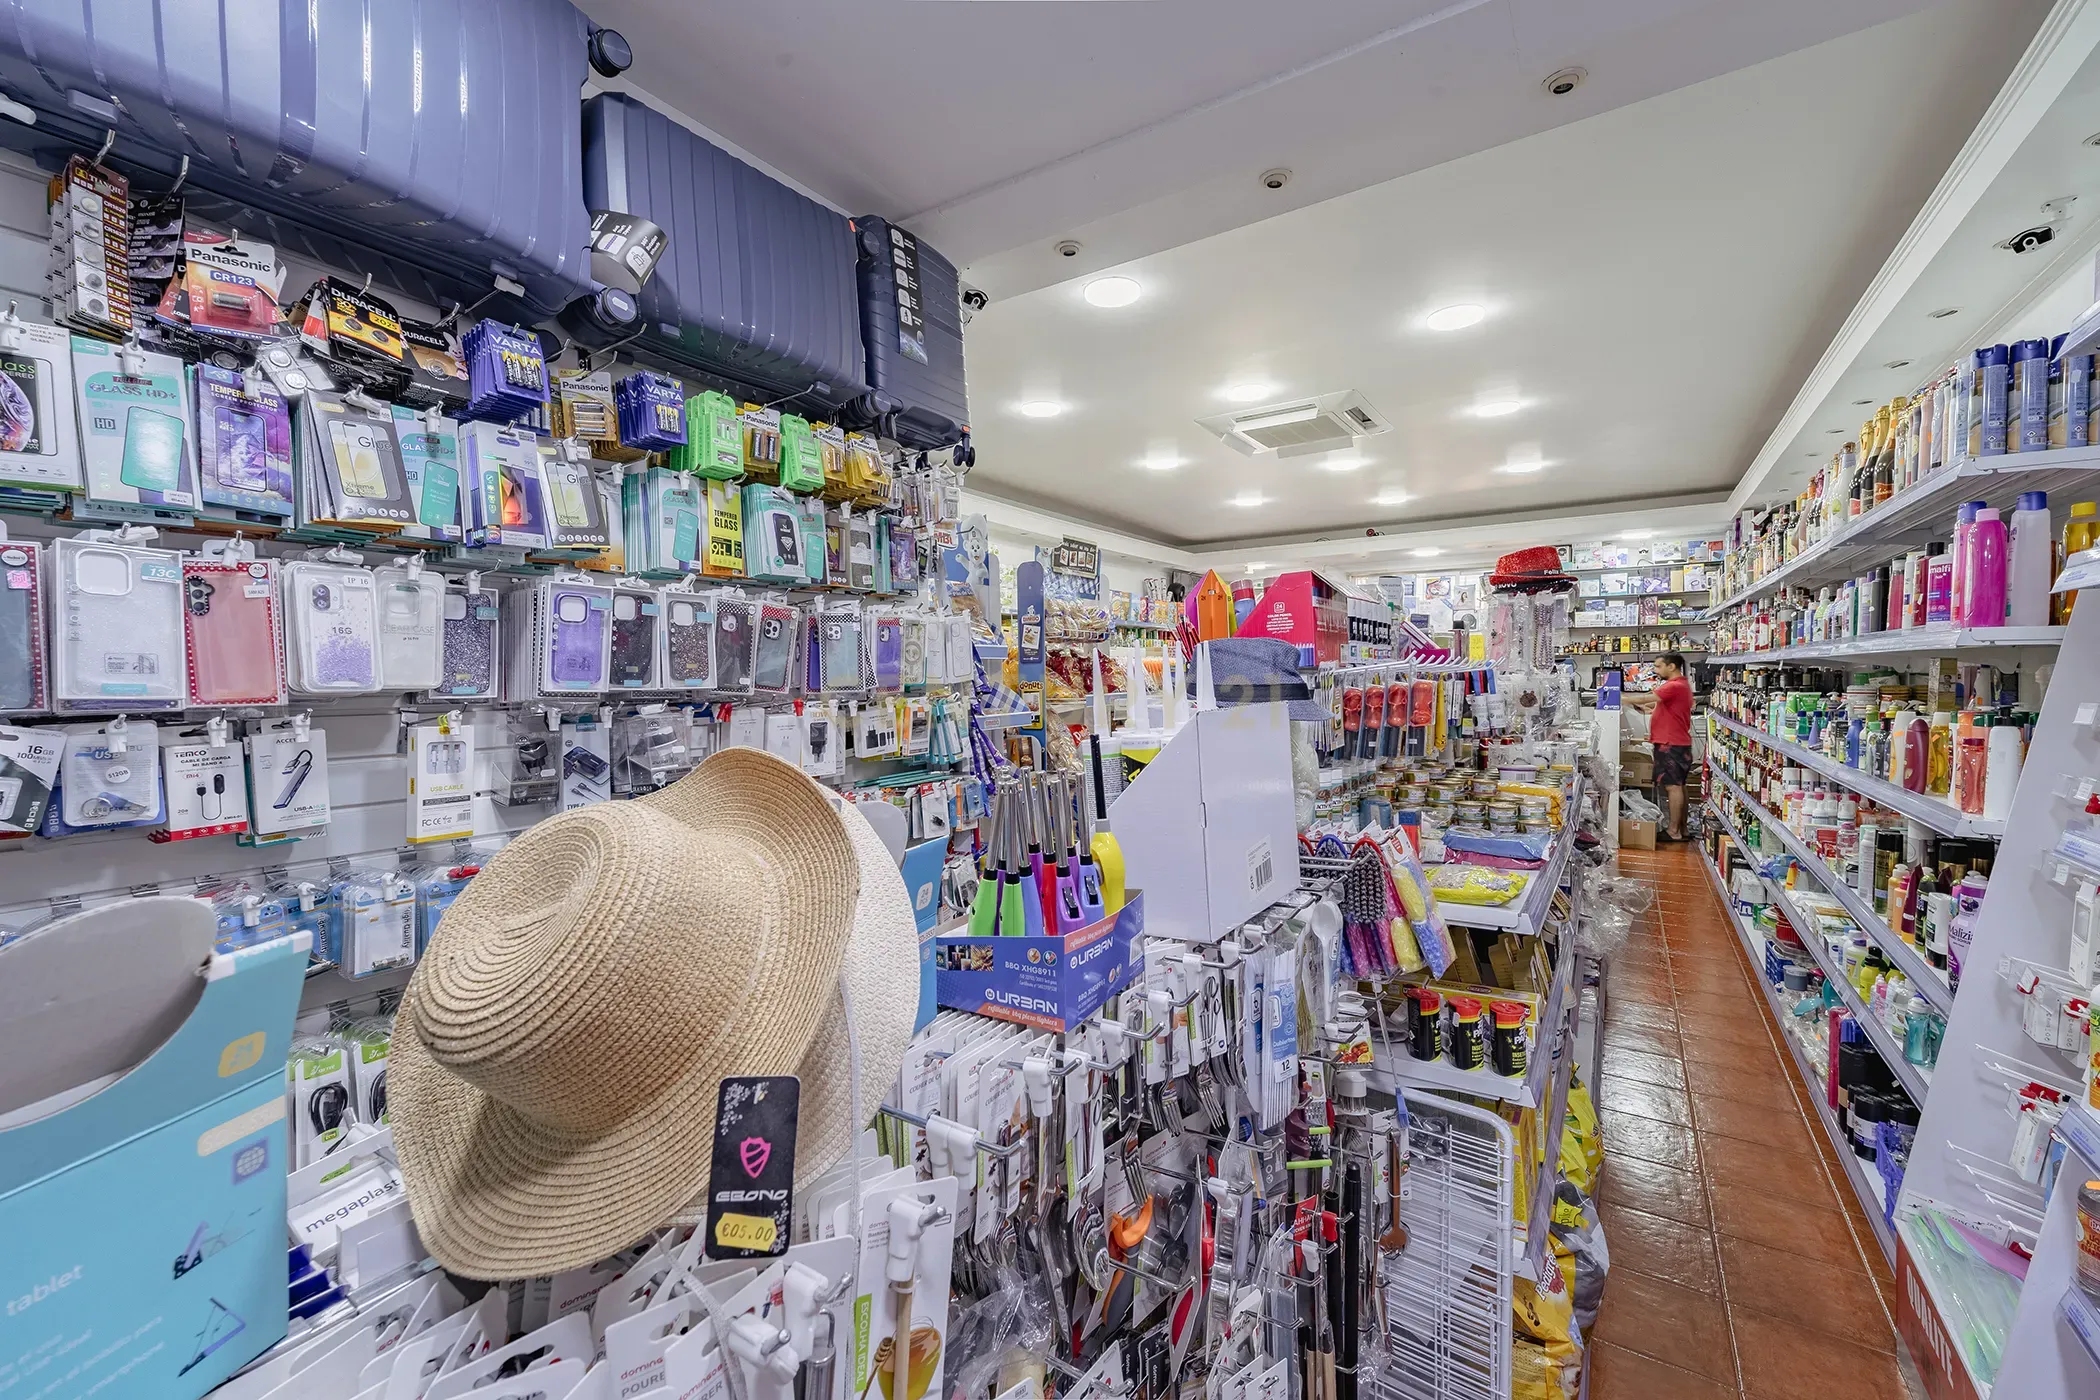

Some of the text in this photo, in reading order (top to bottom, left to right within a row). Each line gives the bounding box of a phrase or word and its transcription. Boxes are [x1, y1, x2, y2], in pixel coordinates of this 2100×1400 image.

[191, 248, 272, 273] Panasonic
[212, 272, 253, 285] CR123
[331, 287, 396, 322] DURACELL
[374, 317, 398, 330] 2025
[402, 330, 445, 347] DURACELL
[490, 333, 542, 356] VARTA
[562, 381, 609, 392] Panasonic
[645, 382, 684, 402] VARTA
[96, 418, 114, 430] HD
[746, 414, 778, 428] Panasonic
[358, 436, 394, 452] Glue
[714, 509, 738, 521] TEMPERED
[714, 516, 738, 532] GLASS
[712, 542, 726, 556] 9H
[150, 568, 176, 578] 13C
[332, 626, 353, 635] 16G
[412, 625, 434, 634] CASE
[1020, 681, 1044, 690] donuts
[174, 750, 207, 758] TEMCO
[108, 770, 129, 778] 512GB
[1078, 937, 1114, 965] URBAN
[1005, 962, 1056, 978] BBQ XHG8911
[997, 992, 1058, 1015] URBAN
[1282, 1060, 1290, 1072] 12
[716, 1190, 788, 1203] EBONO
[306, 1178, 400, 1233] megaplast
[722, 1222, 774, 1242] €05.00
[6, 1264, 85, 1316] tablet
[856, 1301, 870, 1385] ESCOLHA IDEAL
[622, 1370, 666, 1398] POURE
